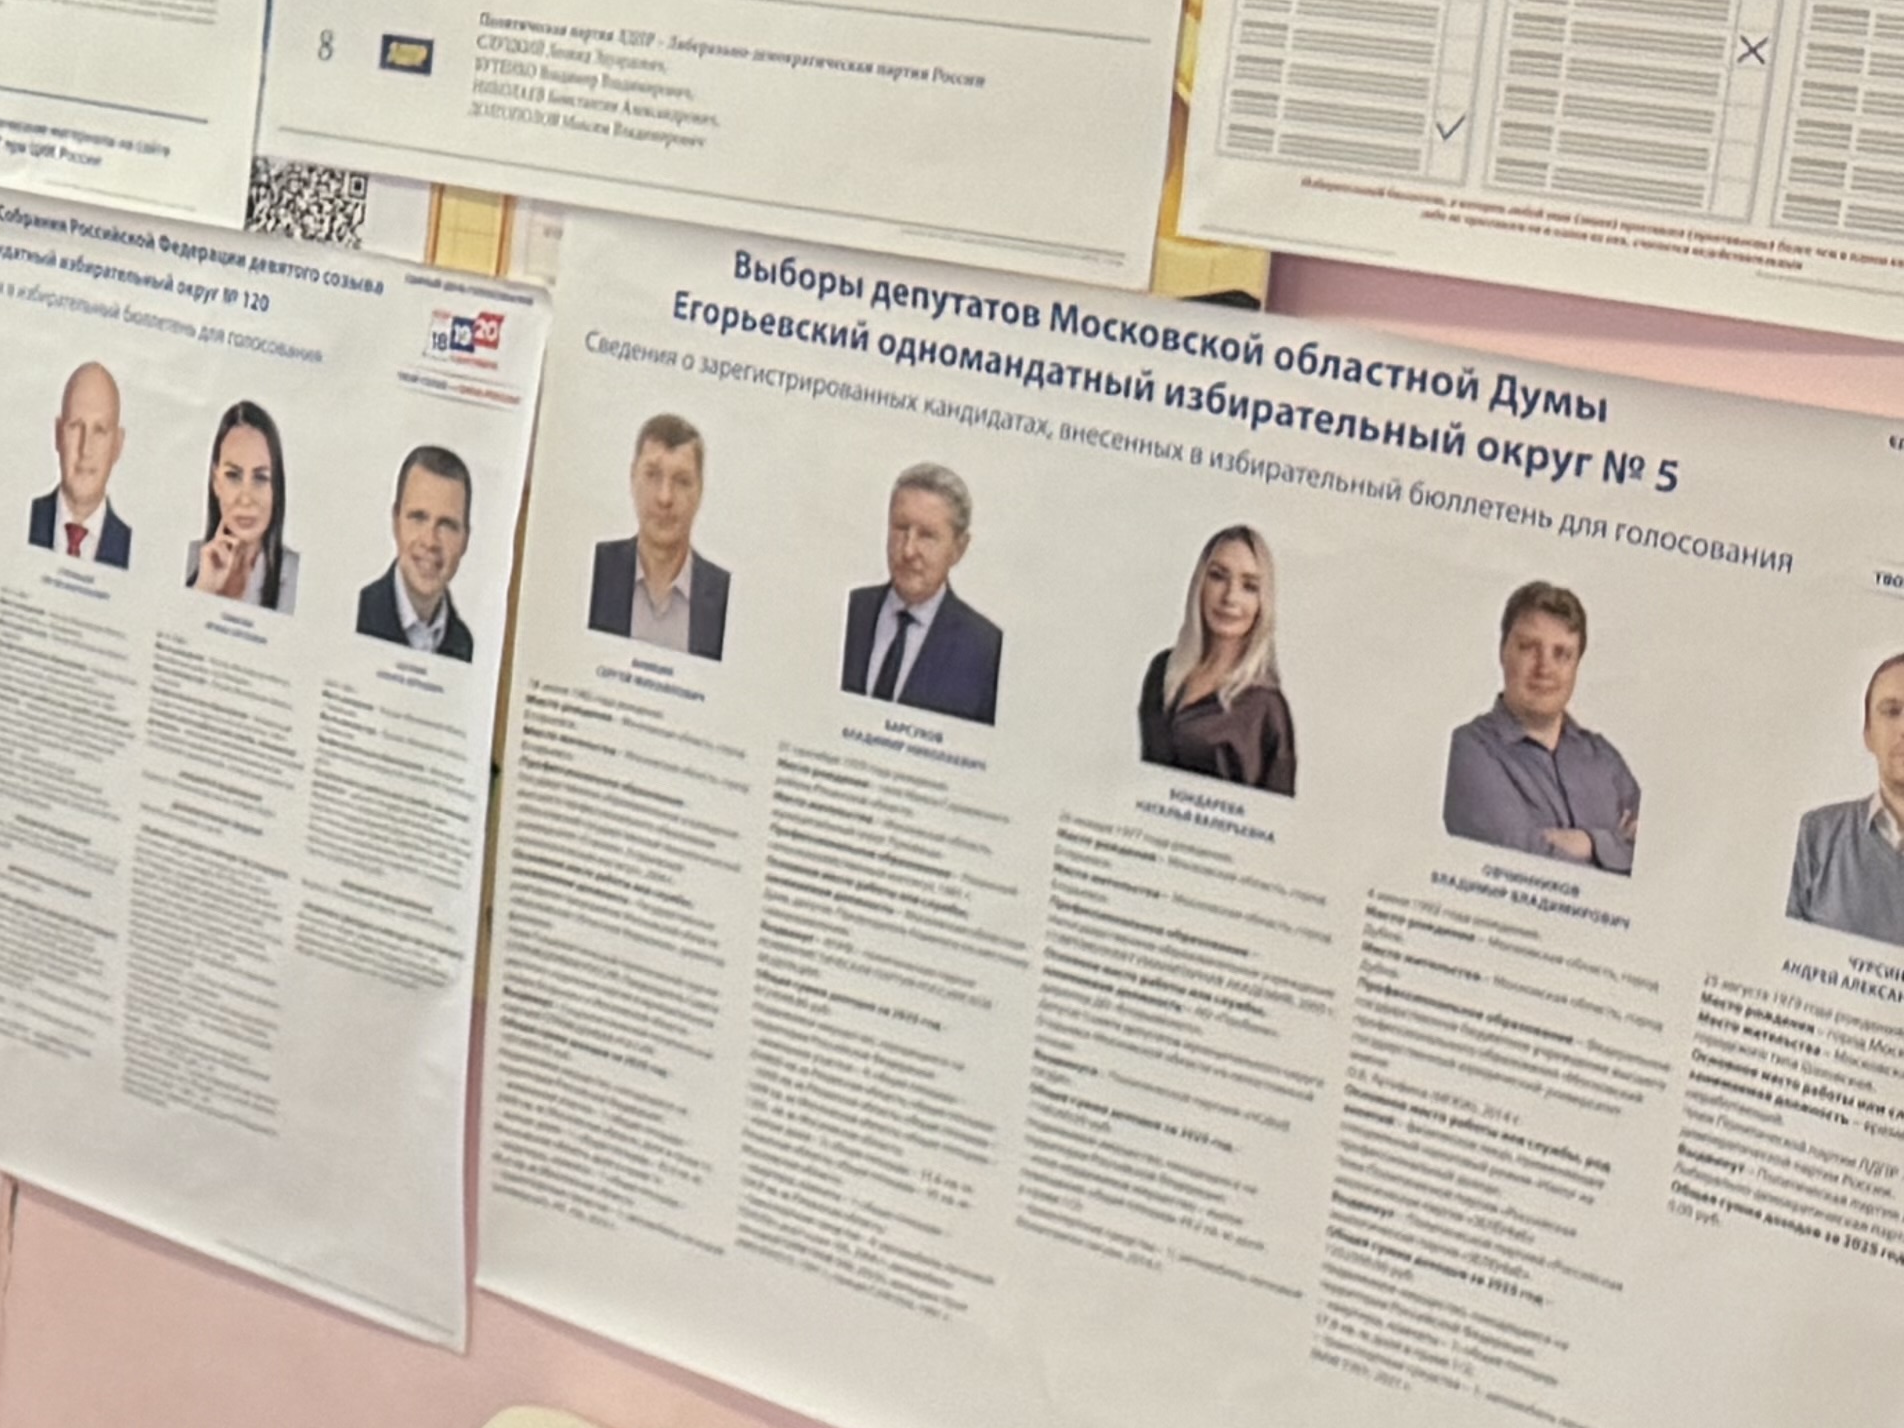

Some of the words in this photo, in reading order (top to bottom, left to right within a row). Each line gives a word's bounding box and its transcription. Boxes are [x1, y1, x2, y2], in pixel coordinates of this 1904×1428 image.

[316, 29, 335, 63] 8
[59, 255, 176, 291] избирательный
[177, 279, 218, 303] округ
[242, 290, 271, 313] 120
[69, 219, 155, 251] Российской
[158, 235, 246, 267] Федерации
[248, 256, 320, 283] девятого
[323, 271, 385, 296] созыва
[432, 331, 448, 351] 18
[474, 318, 499, 342] 20
[734, 249, 864, 304] Выборы
[870, 277, 1041, 328] депутатов
[1050, 298, 1265, 368] Московской
[1274, 342, 1480, 403] областной
[1489, 375, 1609, 424] Думы
[673, 289, 869, 354] Егорьевский
[877, 334, 1154, 404] одномандатный
[1165, 383, 1466, 457] избирательный
[1476, 435, 1594, 484] округ
[1603, 448, 1646, 484] №
[1655, 459, 1679, 493] 5
[584, 331, 678, 369] Сведения
[682, 354, 695, 373] о
[700, 357, 918, 413] зарегистрированных
[923, 397, 1054, 442] кандидатах,
[1059, 422, 1184, 463] внесенных
[1189, 447, 1203, 467] в
[1209, 449, 1403, 502] избирательный
[1408, 483, 1553, 530] бюллетень
[1558, 514, 1608, 541] для
[1615, 525, 1793, 575] голосования
[1781, 957, 1838, 987] АНДРЕЙ
